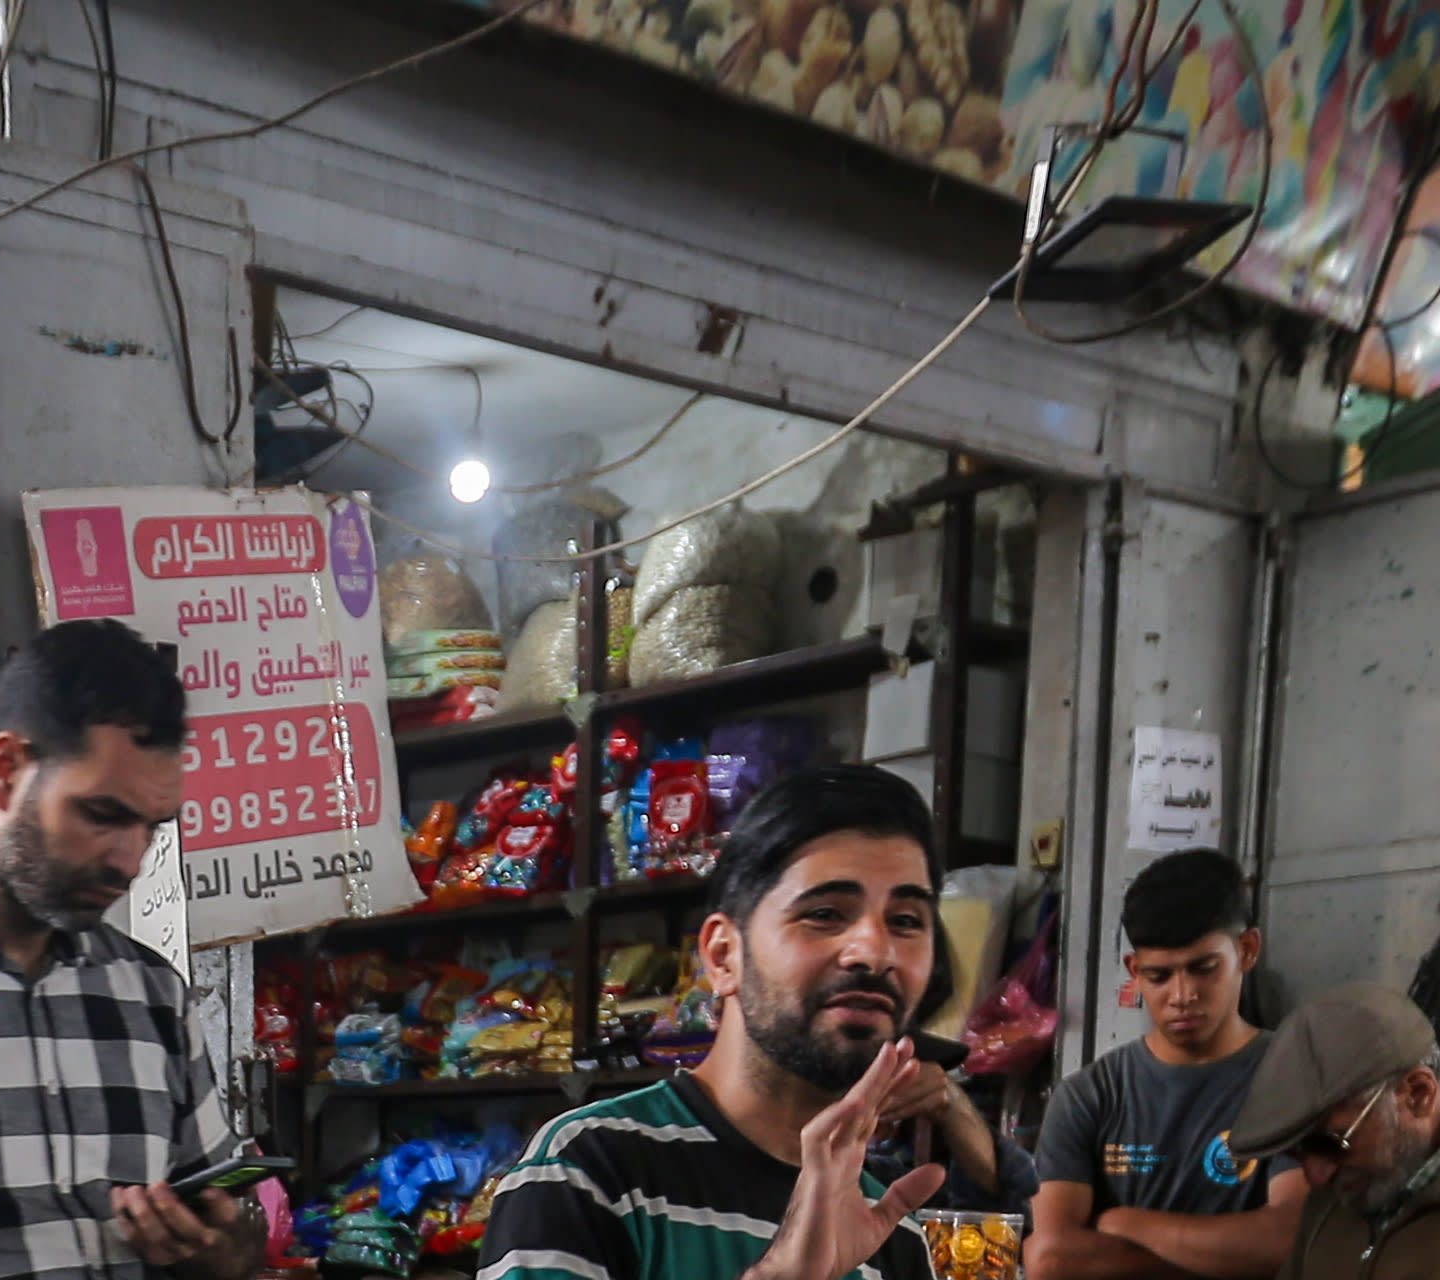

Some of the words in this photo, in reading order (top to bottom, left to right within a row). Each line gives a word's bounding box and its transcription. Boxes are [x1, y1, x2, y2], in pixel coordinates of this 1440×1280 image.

[151, 522, 235, 575] الكرام
[178, 586, 248, 637] الدفع
[257, 584, 308, 632] متاح
[182, 649, 242, 699] والم
[252, 640, 345, 697] التطبيق
[350, 653, 372, 689] عبر
[182, 778, 377, 838] 99852317
[186, 857, 231, 901] الدا
[243, 849, 303, 900] خليل
[313, 849, 374, 881] محمد
